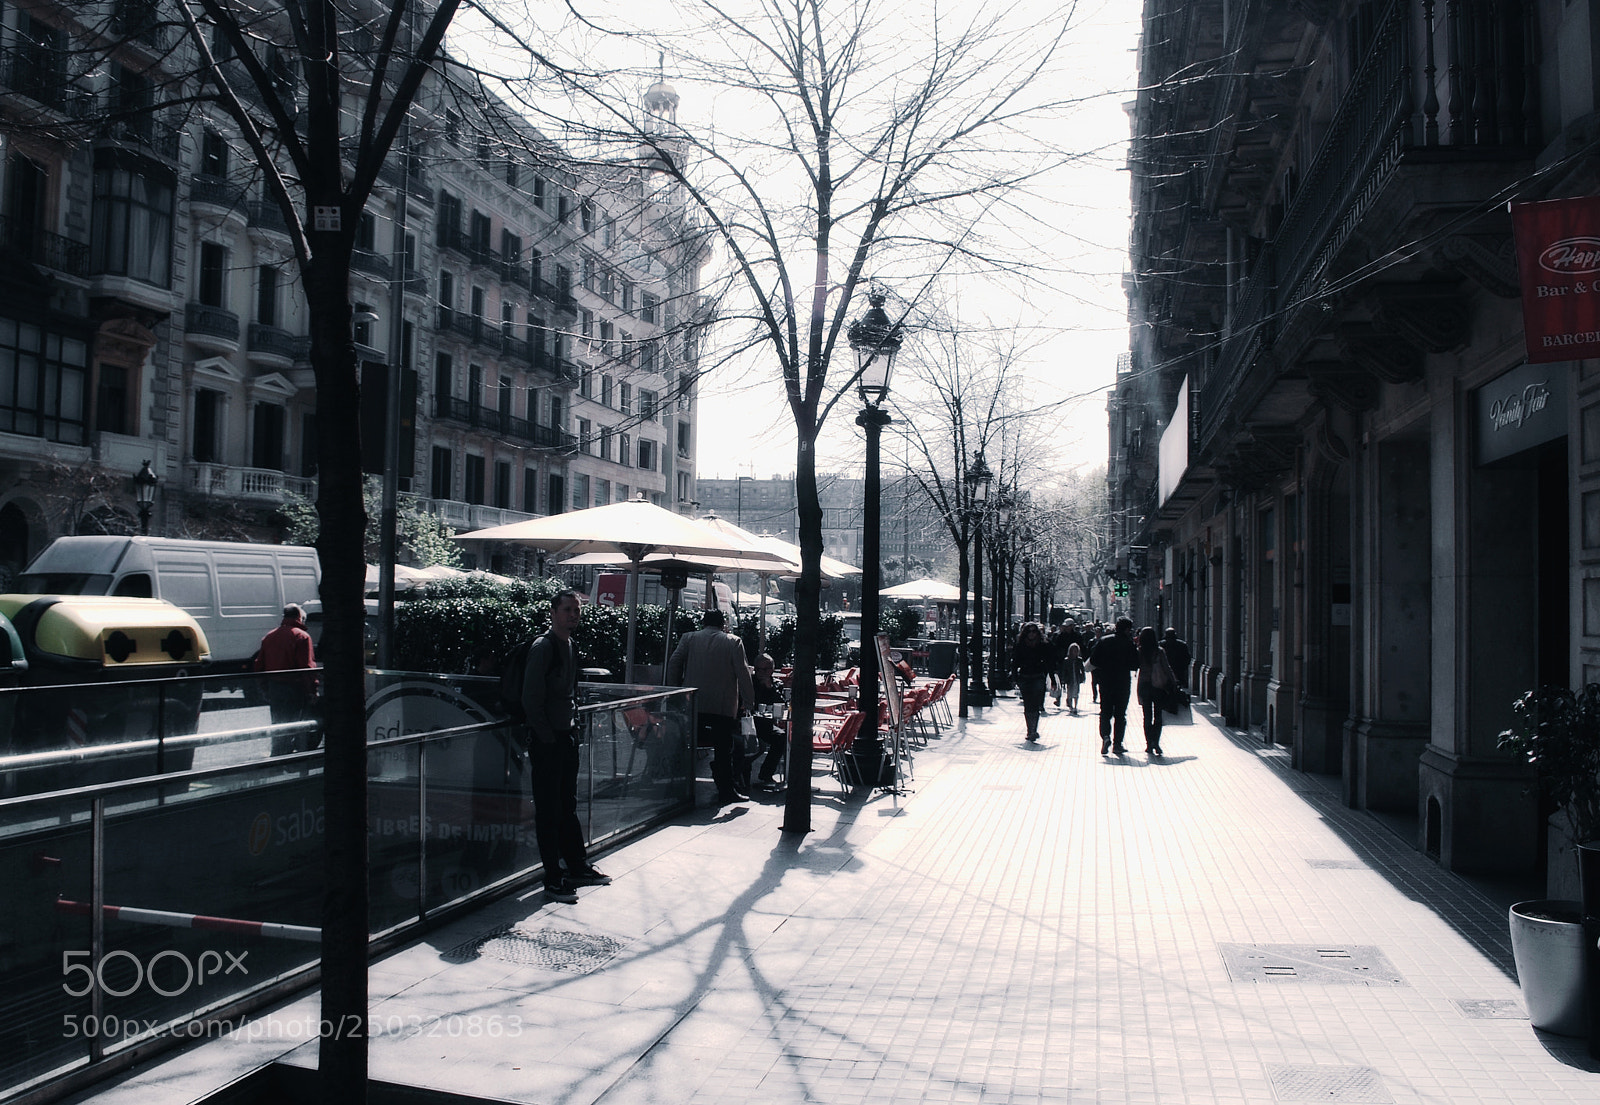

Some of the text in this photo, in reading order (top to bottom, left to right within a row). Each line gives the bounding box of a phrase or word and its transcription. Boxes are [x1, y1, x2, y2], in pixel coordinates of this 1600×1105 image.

[1537, 285, 1569, 298] Bar
[1574, 281, 1588, 294] &
[1489, 379, 1550, 432] Vanity Fair
[274, 796, 325, 846] saba
[369, 814, 432, 837] IBRES
